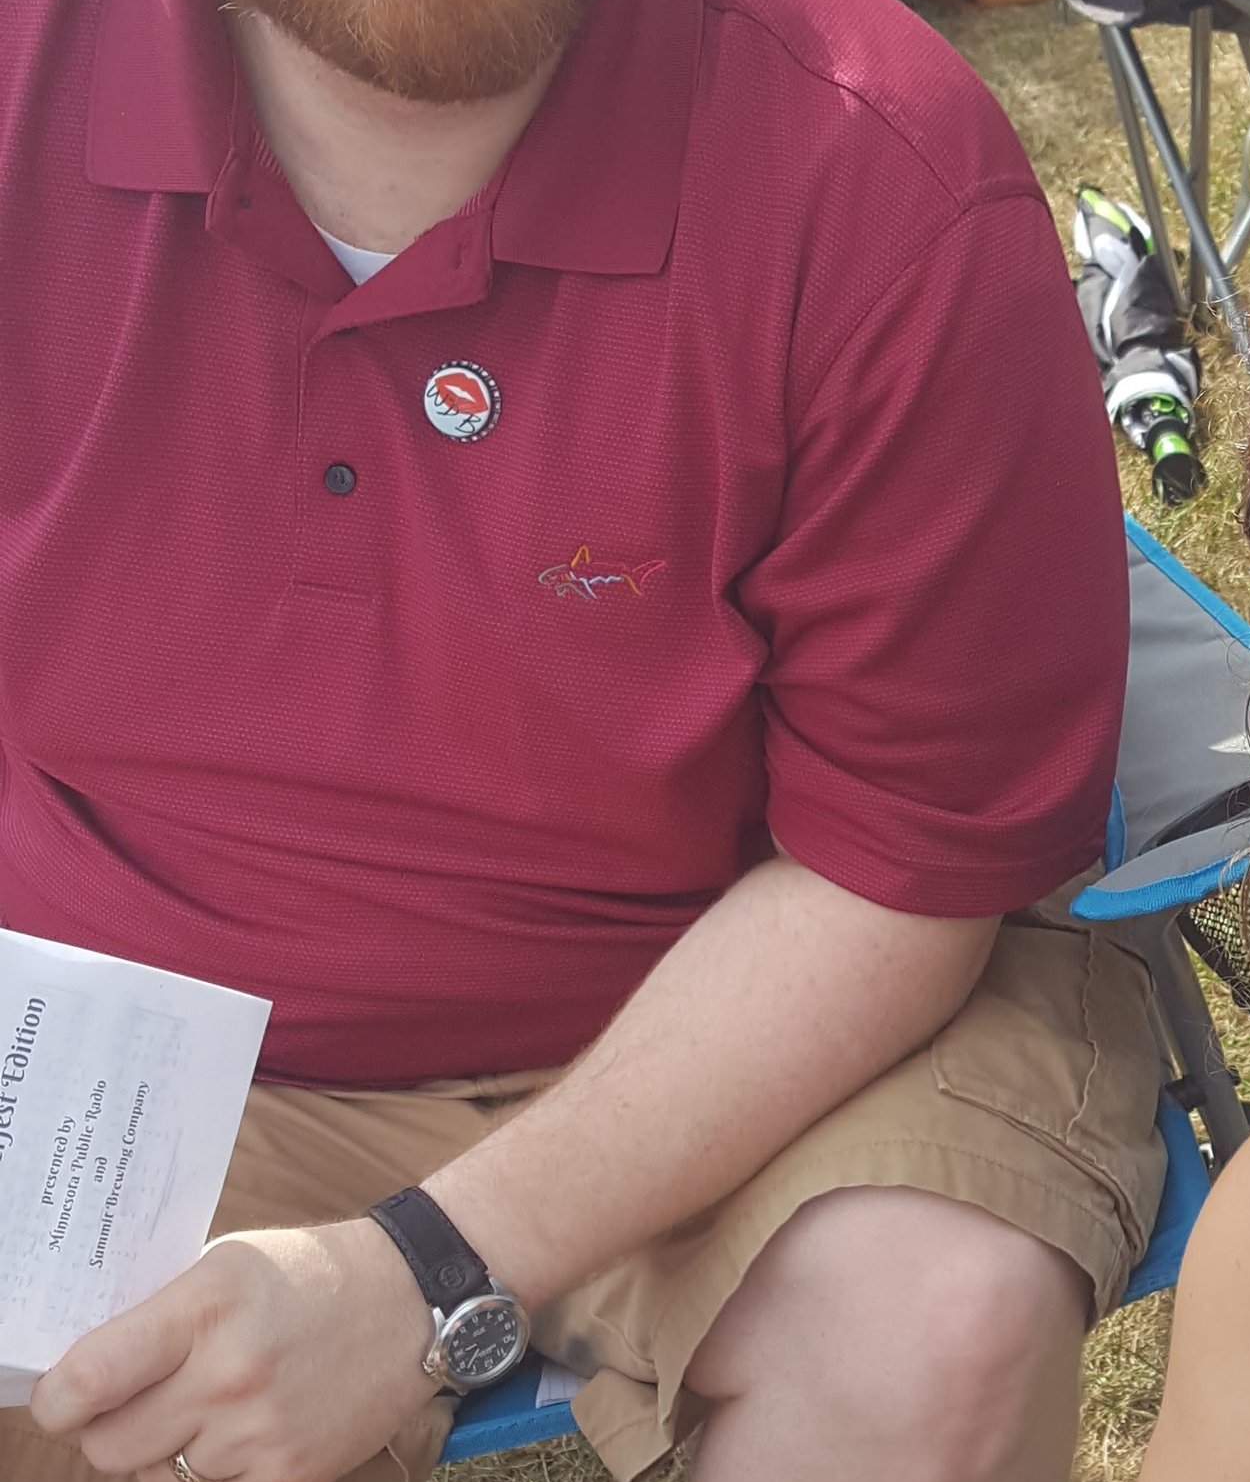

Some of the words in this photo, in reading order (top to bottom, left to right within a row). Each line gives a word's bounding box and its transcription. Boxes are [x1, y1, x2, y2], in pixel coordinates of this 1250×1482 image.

[1, 997, 46, 1087] Edition
[41, 1136, 68, 1205] presented
[57, 1116, 76, 1133] by
[49, 1176, 80, 1252] Minnesota
[71, 1126, 94, 1172] Public
[85, 1080, 106, 1122] Radio
[89, 1212, 114, 1269] Summit
[105, 1148, 133, 1209] Brewing
[122, 1081, 150, 1145] Company
[94, 1156, 107, 1183] and
